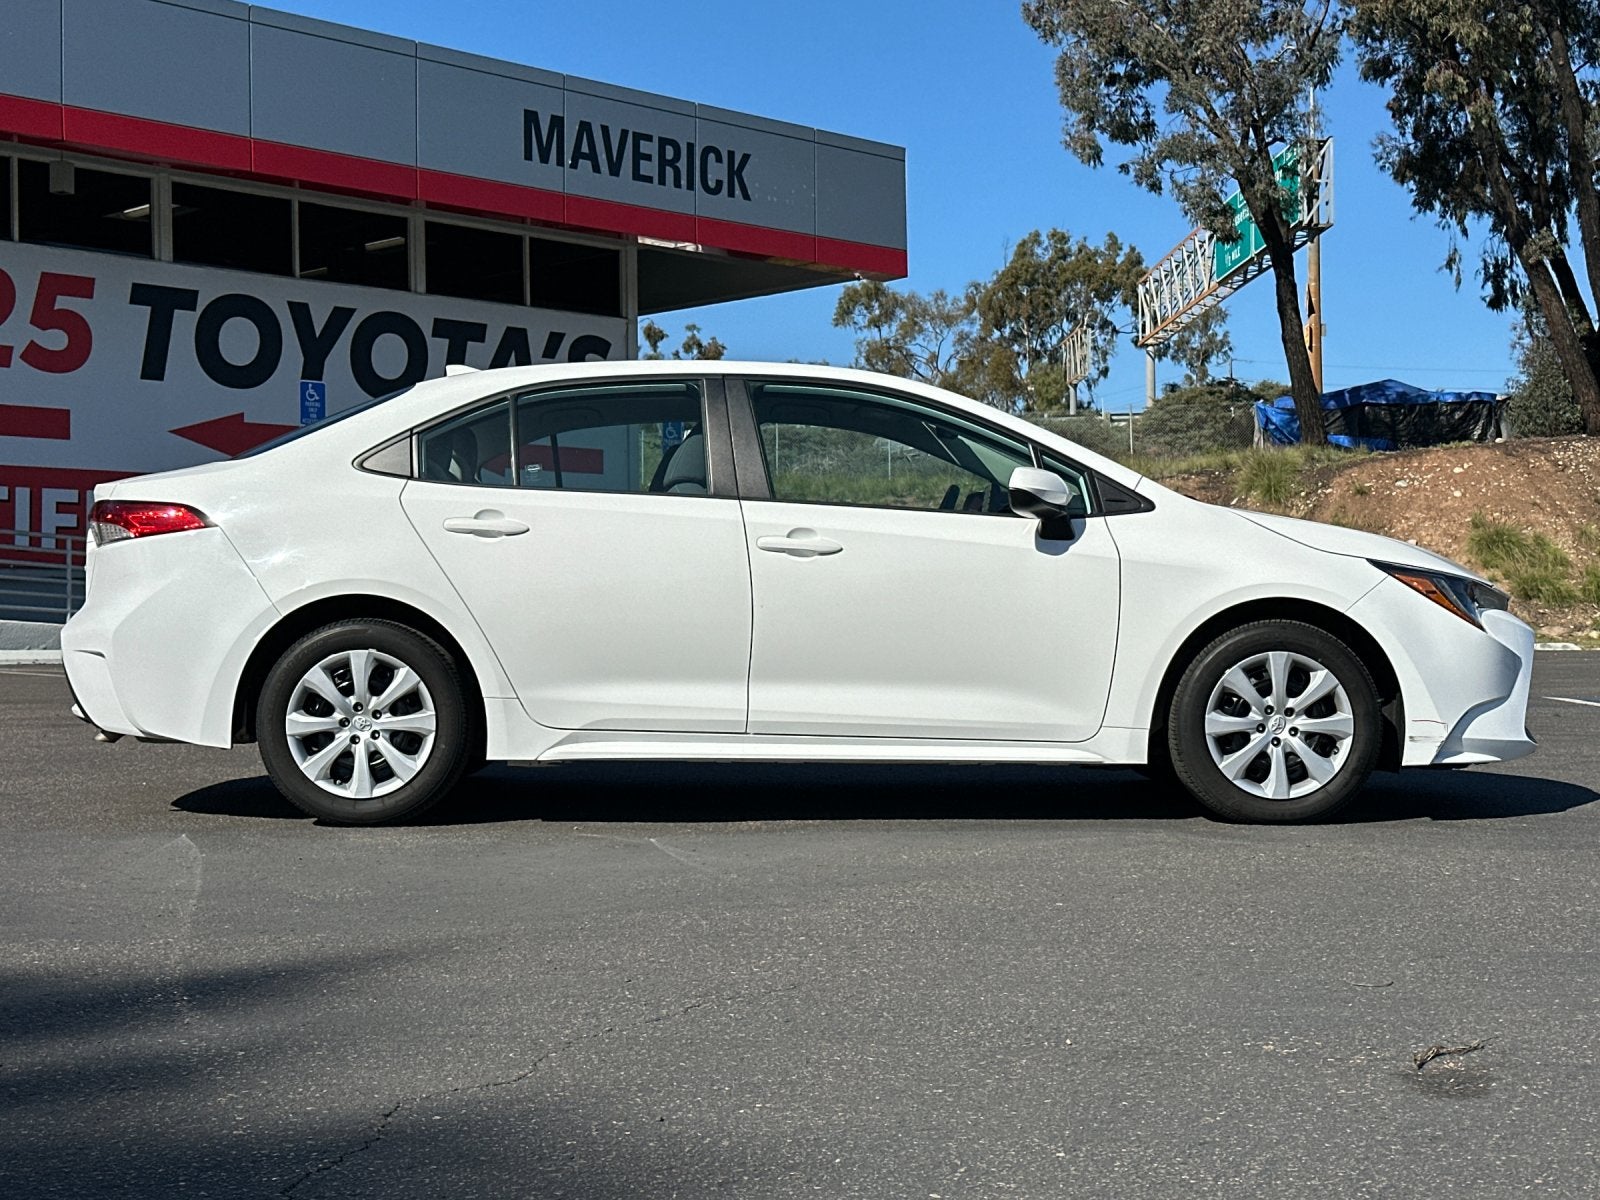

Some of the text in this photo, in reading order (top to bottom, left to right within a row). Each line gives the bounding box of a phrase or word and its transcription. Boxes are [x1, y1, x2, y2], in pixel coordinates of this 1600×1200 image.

[523, 108, 752, 201] MAVERICK
[0, 267, 96, 374] 5
[0, 485, 94, 549] IF
